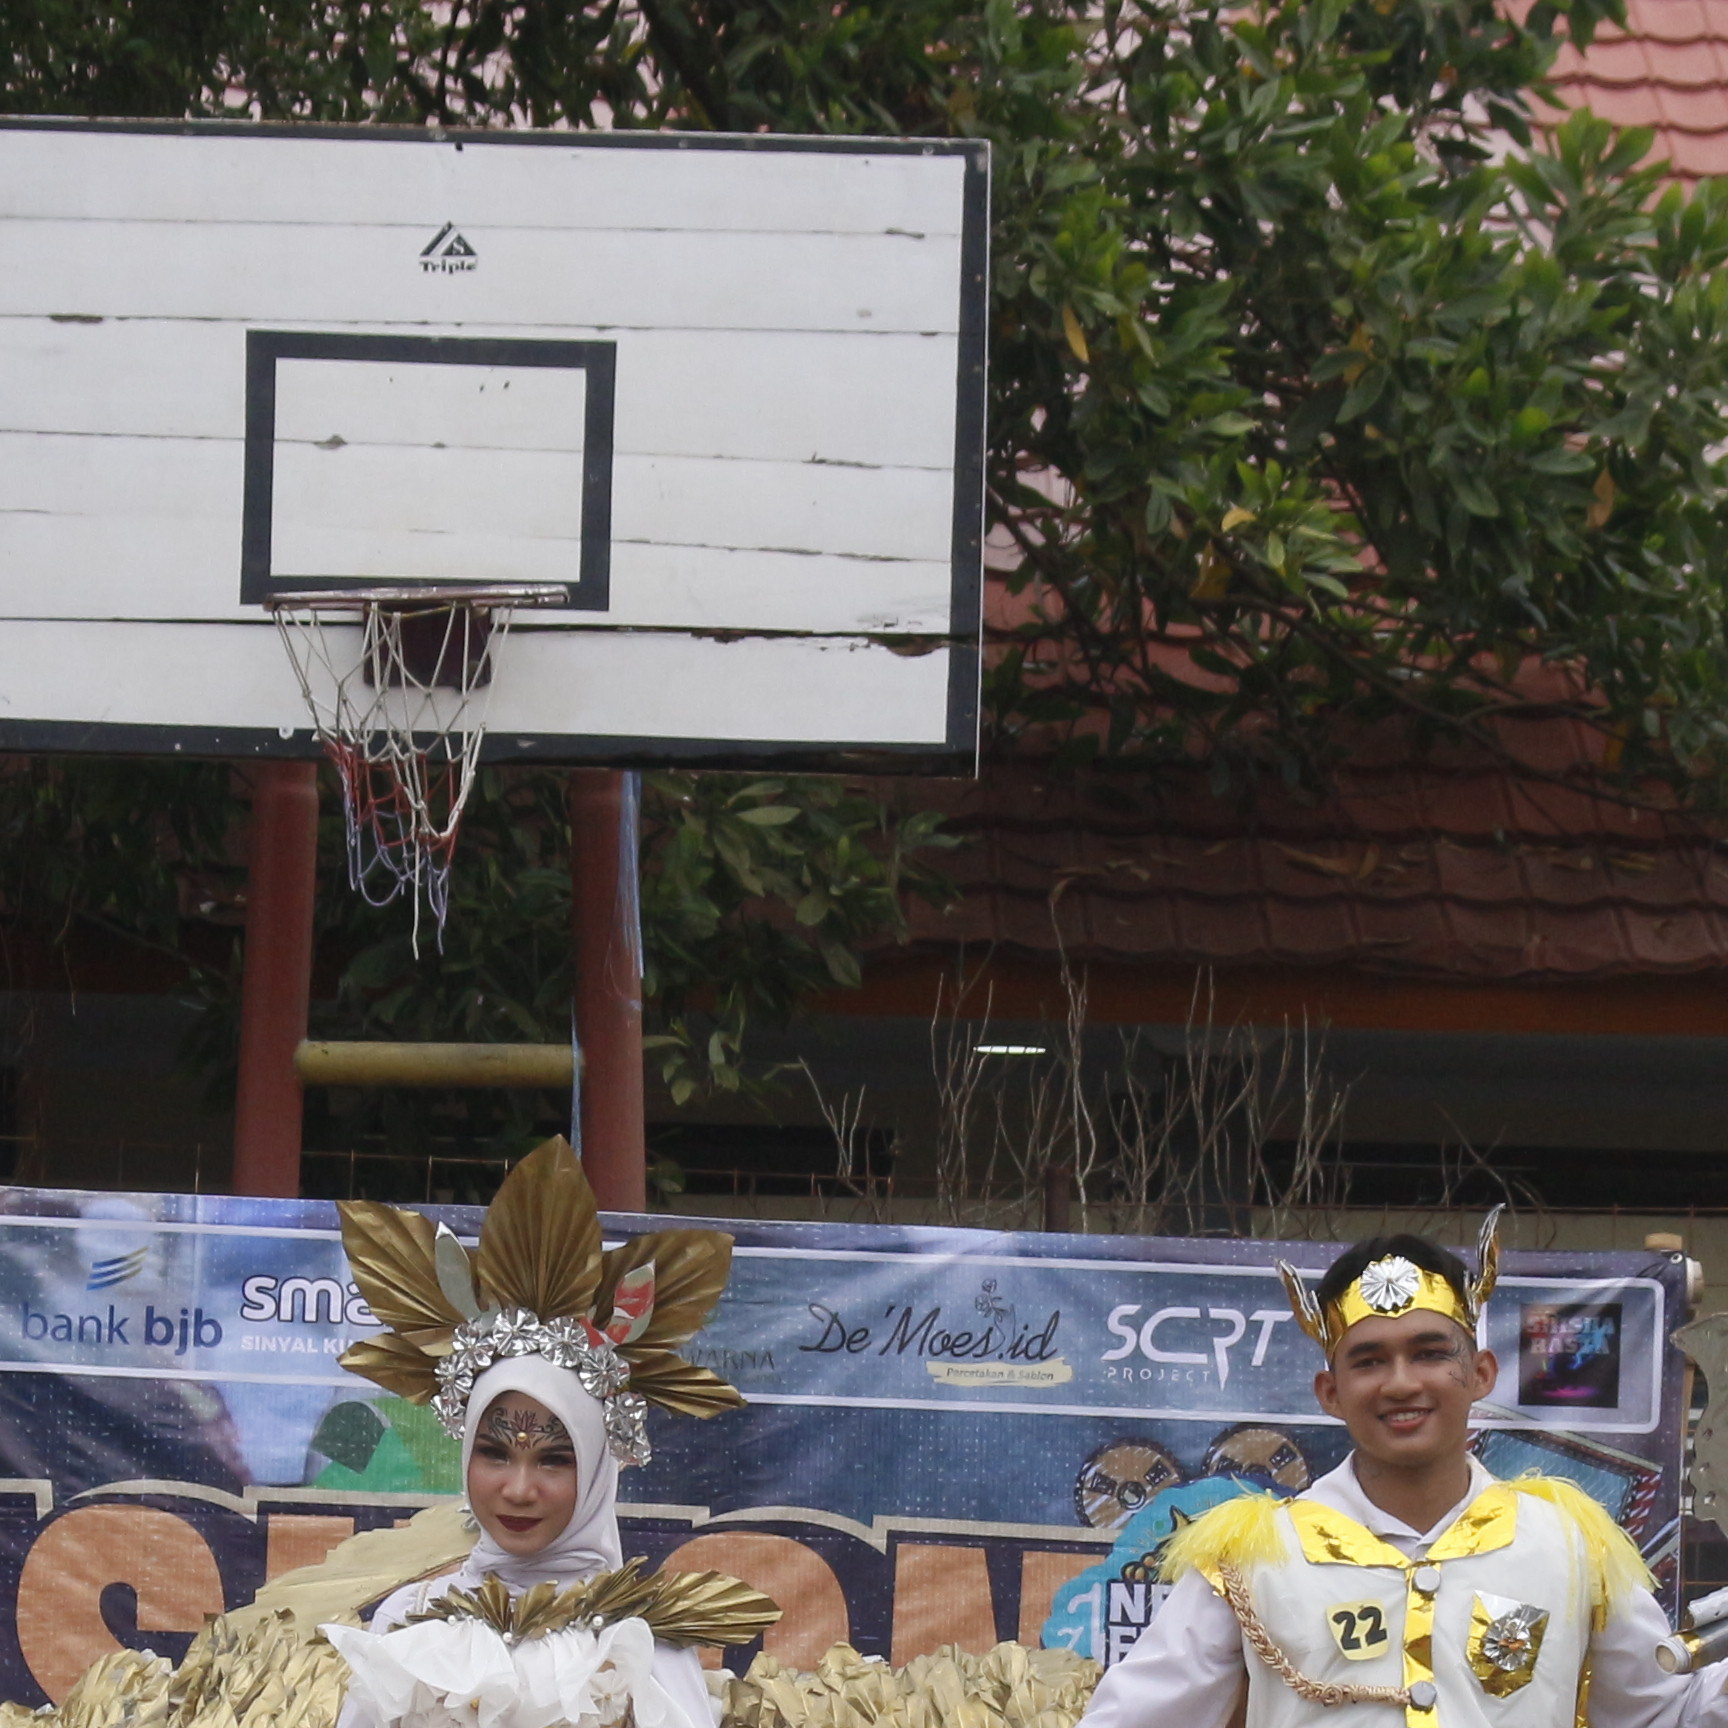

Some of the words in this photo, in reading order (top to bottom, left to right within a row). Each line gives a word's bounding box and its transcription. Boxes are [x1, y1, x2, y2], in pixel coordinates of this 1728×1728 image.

[21, 1301, 130, 1346] bank
[144, 1305, 224, 1357] bjb
[240, 1335, 320, 1354] SINYAL
[1106, 1366, 1211, 1382] PROJECT
[1331, 1604, 1389, 1652] 22
